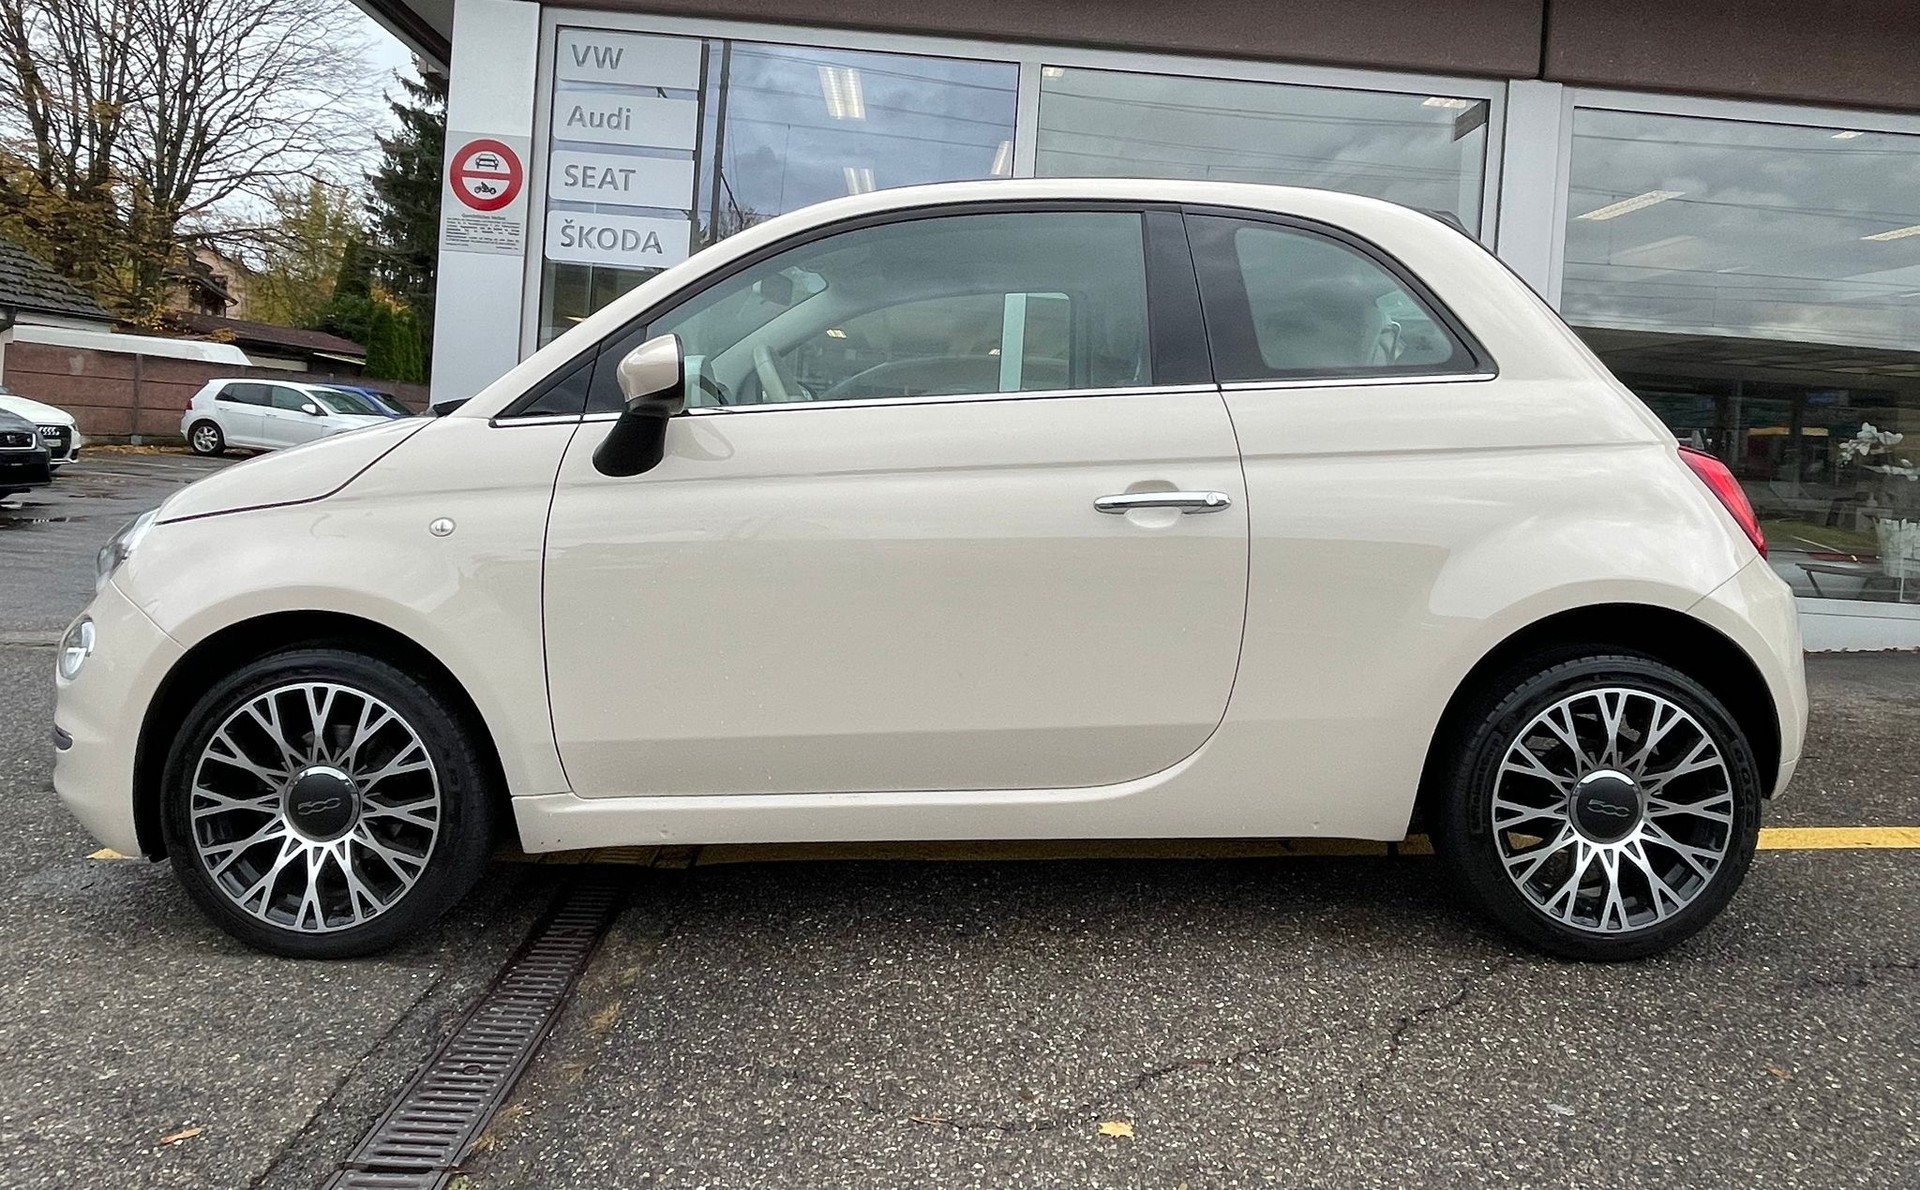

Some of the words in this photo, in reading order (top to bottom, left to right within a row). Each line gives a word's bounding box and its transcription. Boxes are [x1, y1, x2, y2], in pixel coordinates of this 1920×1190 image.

[571, 44, 624, 69] VW
[567, 104, 631, 131] Audi
[563, 163, 636, 191] SEAT
[560, 218, 663, 254] ŠKODA
[1586, 799, 1631, 817] 500
